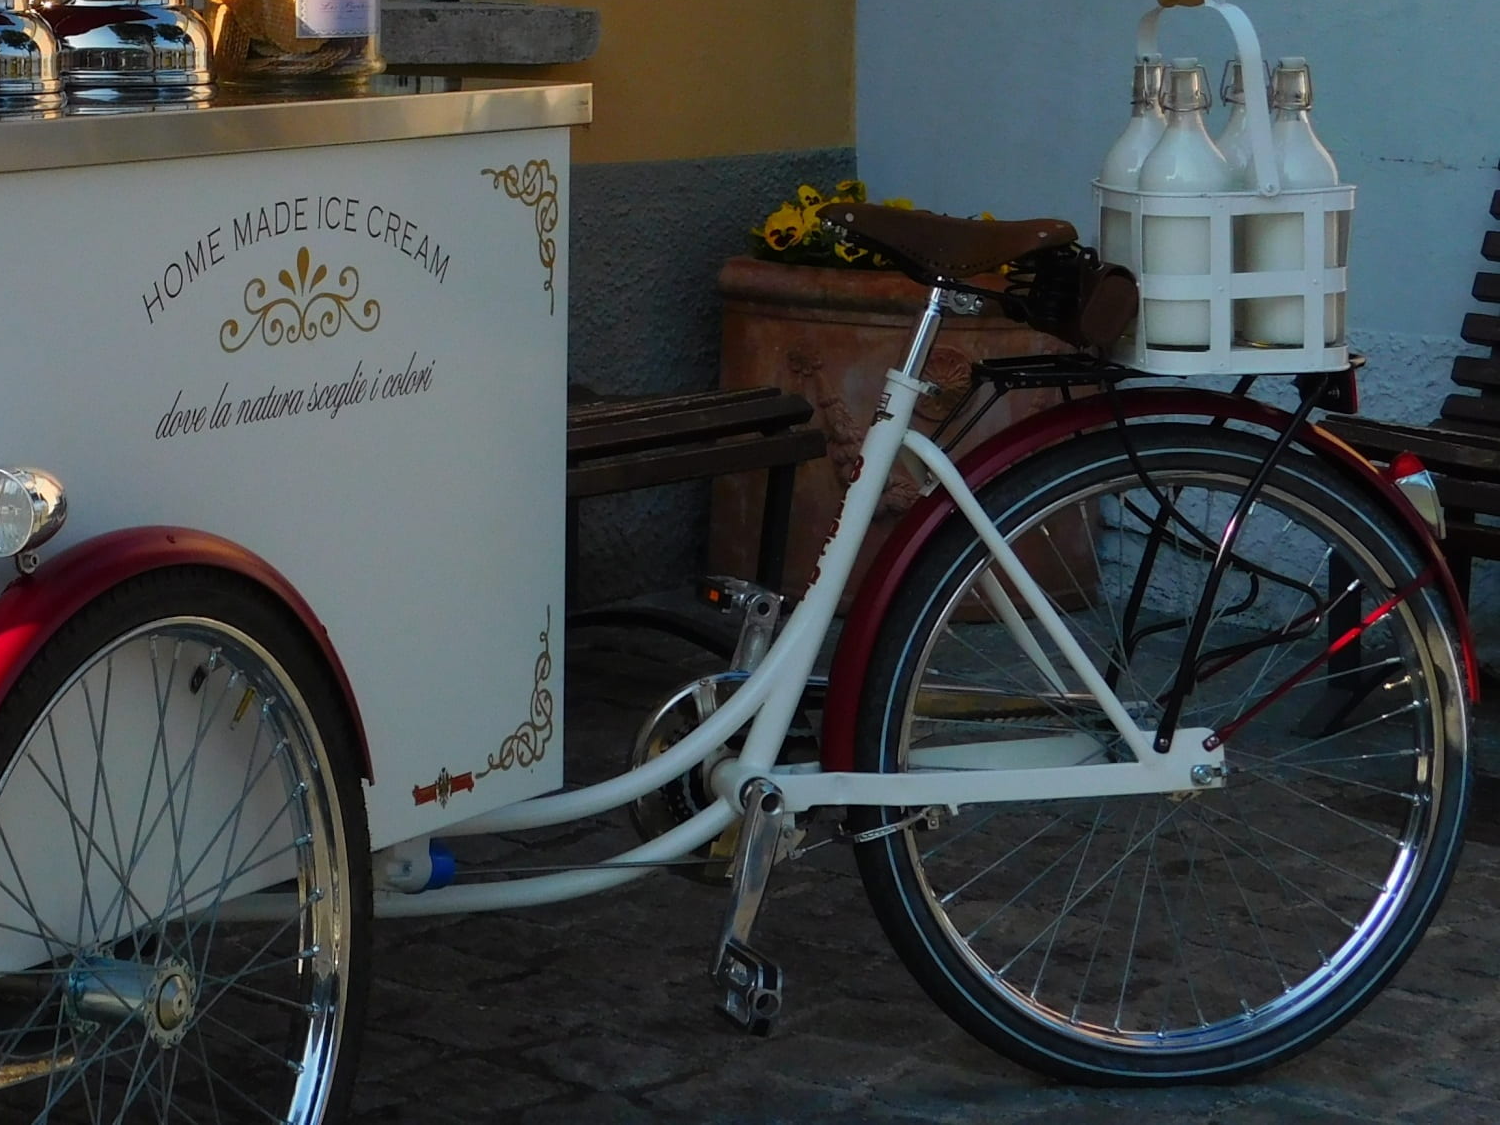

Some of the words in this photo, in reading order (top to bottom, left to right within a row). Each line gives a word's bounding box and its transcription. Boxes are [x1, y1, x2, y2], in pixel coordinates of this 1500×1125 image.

[141, 227, 226, 324] HOME
[233, 196, 309, 252] MADE
[316, 195, 360, 233] ICE
[366, 205, 451, 285] CREAM
[155, 389, 208, 440] dove
[209, 381, 232, 429] la
[236, 385, 304, 425] natura
[306, 359, 368, 419] sceglie
[369, 368, 383, 401] i
[382, 350, 436, 400] colori
